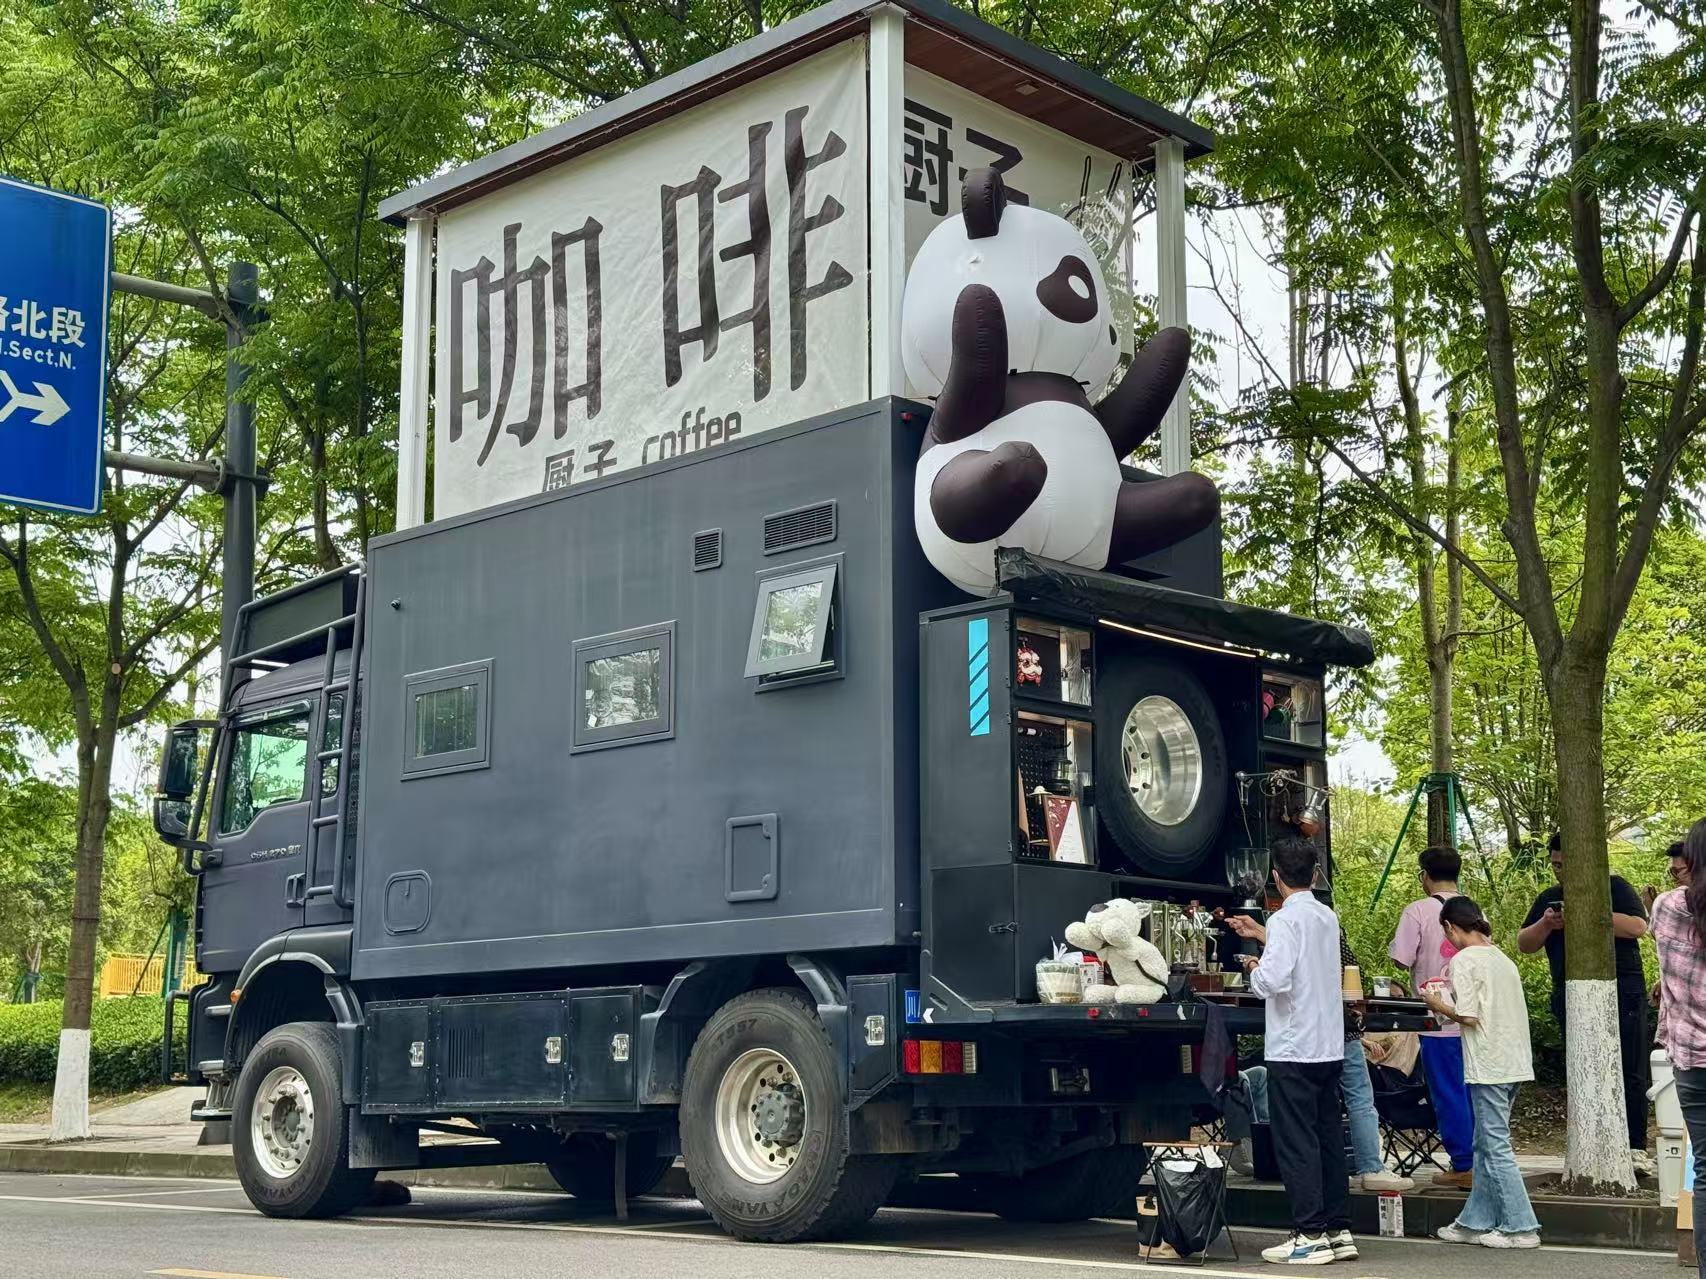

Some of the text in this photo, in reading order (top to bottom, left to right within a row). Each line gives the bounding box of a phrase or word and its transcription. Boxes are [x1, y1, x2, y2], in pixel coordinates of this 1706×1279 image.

[449, 105, 853, 467] 咖啡
[0, 296, 86, 348] 北段
[641, 406, 742, 465] coffee
